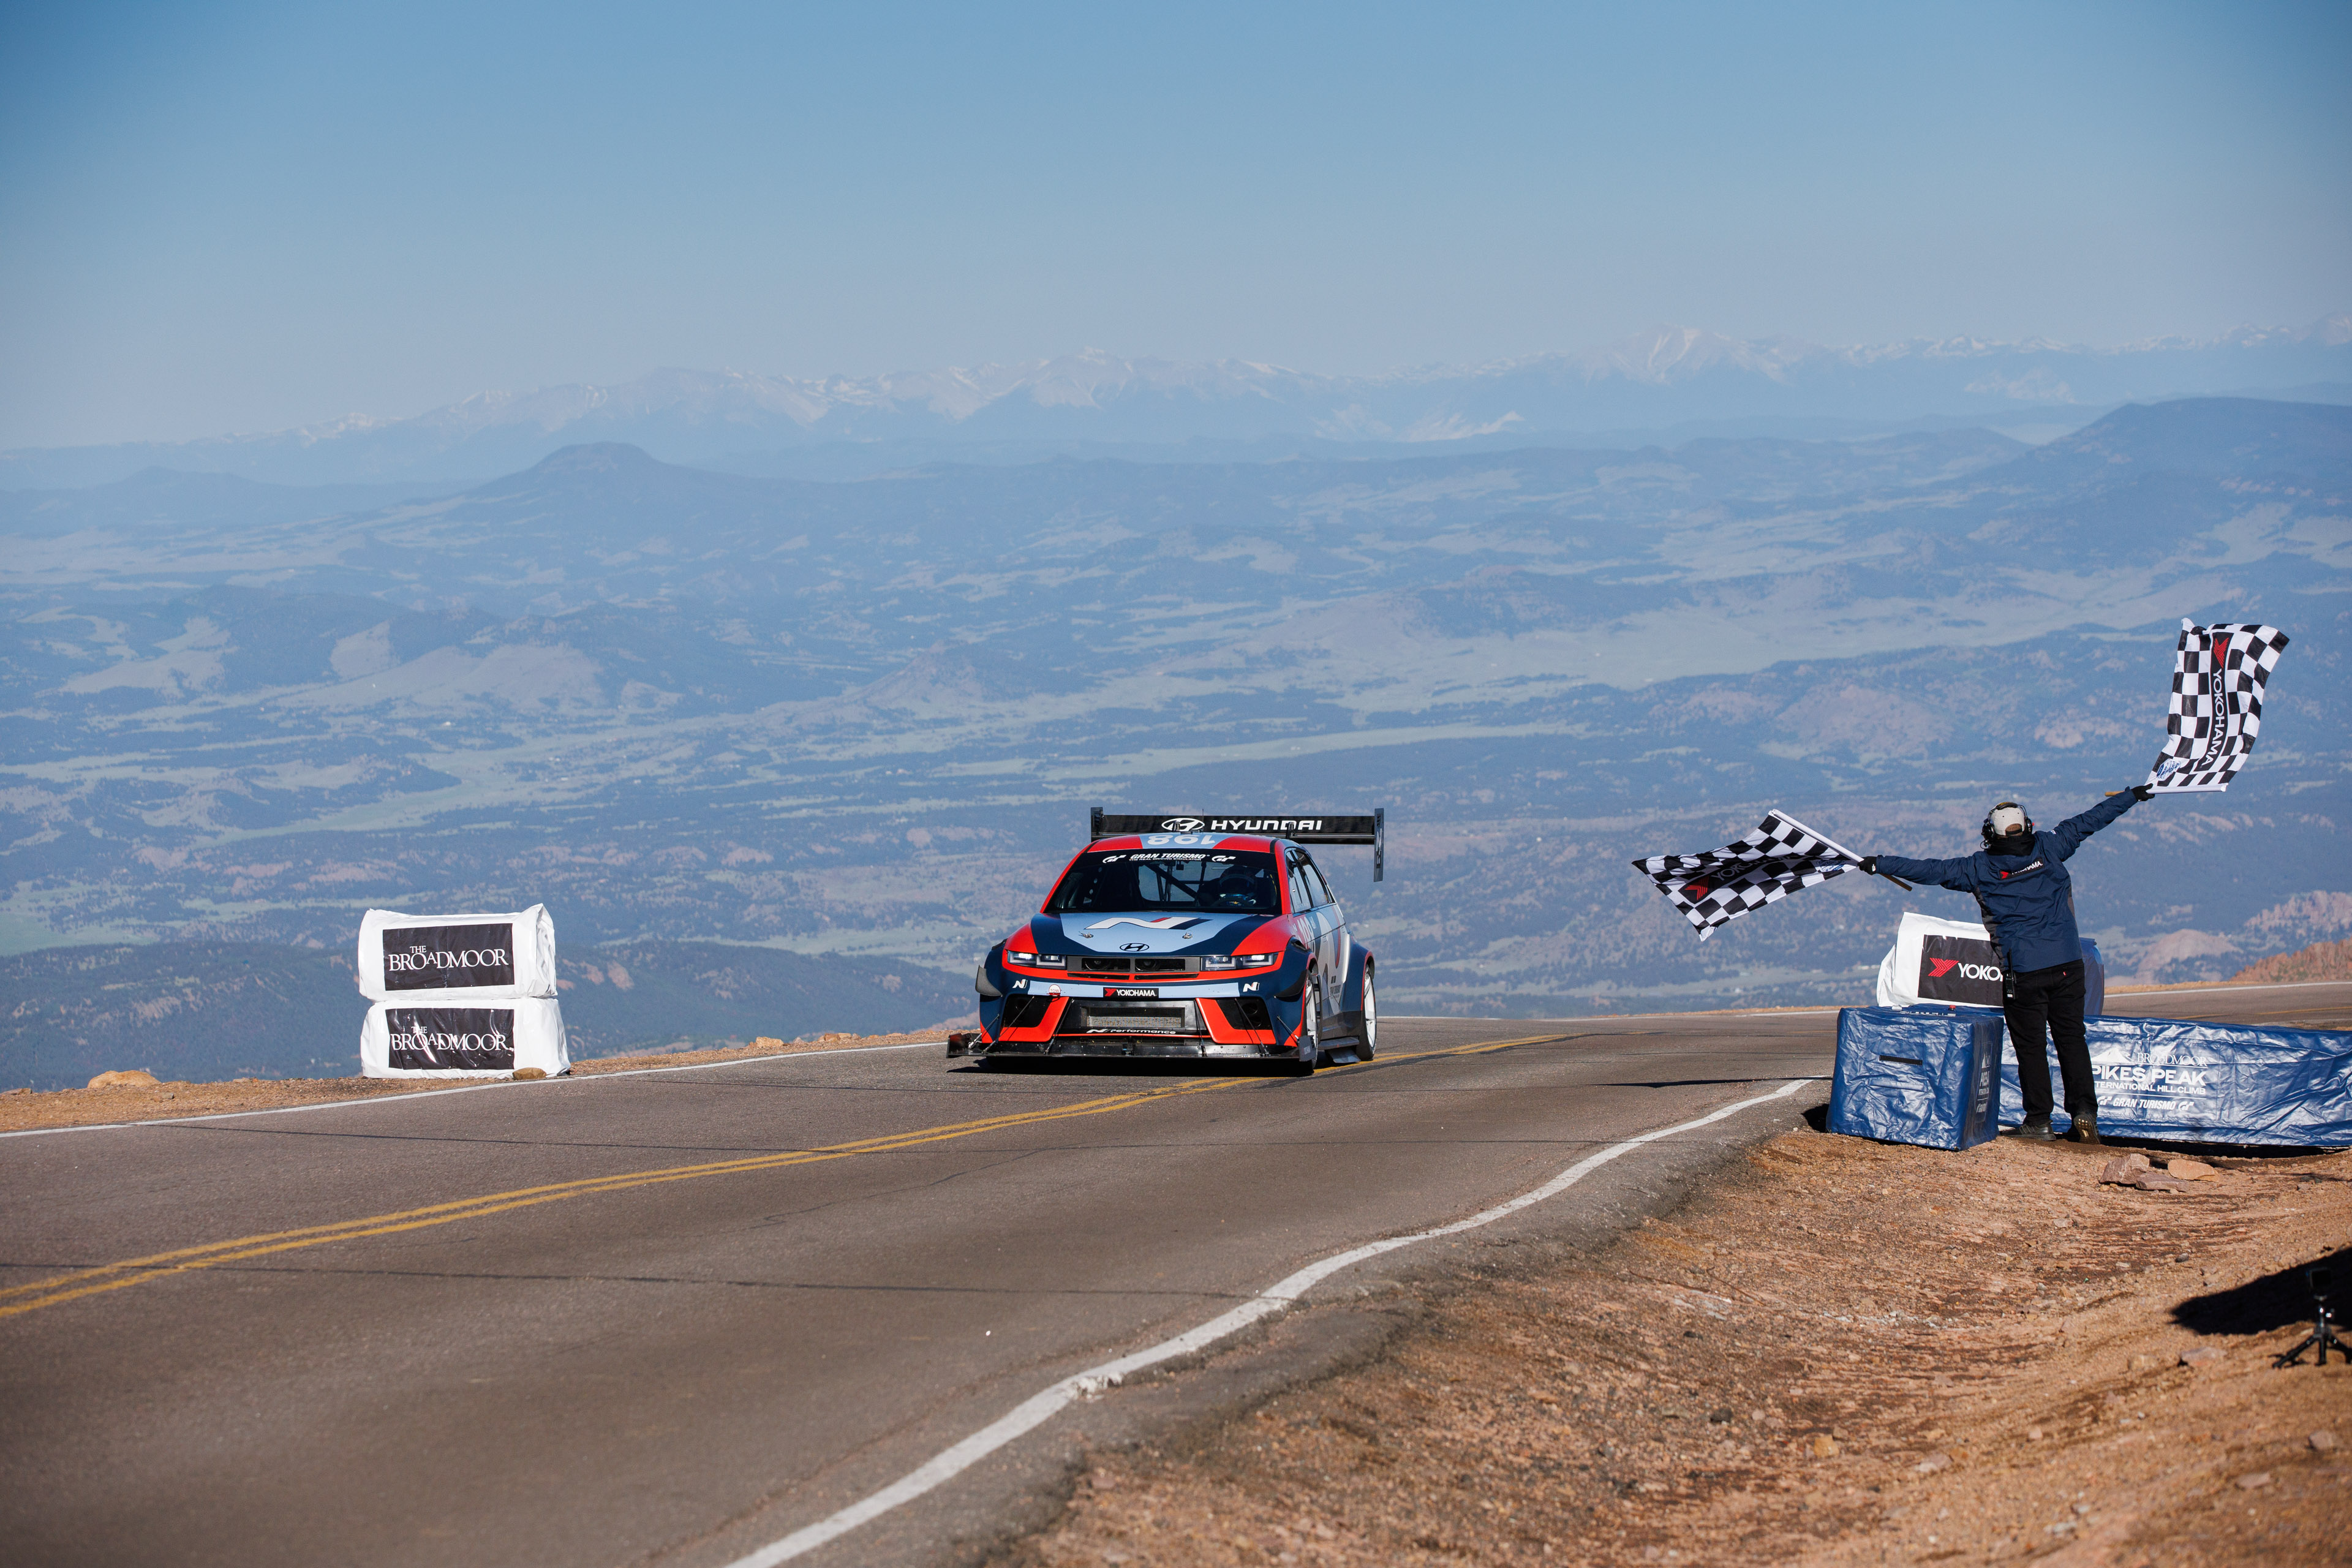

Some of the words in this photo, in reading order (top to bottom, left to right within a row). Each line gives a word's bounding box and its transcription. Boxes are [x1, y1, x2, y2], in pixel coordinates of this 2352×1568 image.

[2201, 668, 2225, 766] YOKOHAMA
[1211, 820, 1322, 831] HYUNDAI
[410, 945, 427, 954] THE
[388, 948, 509, 971] BROADMOOR
[411, 1026, 428, 1035] THE
[390, 1033, 508, 1051] BROADMOOR
[2092, 1065, 2147, 1082] PIKES
[2151, 1068, 2207, 1087] PEAK
[2094, 1080, 2156, 1092] TERNATIONAL
[2157, 1085, 2176, 1093] HILL
[2177, 1086, 2206, 1095] CLIMB
[2113, 1097, 2138, 1108] GRAN
[2138, 1099, 2176, 1110] TURISMO
